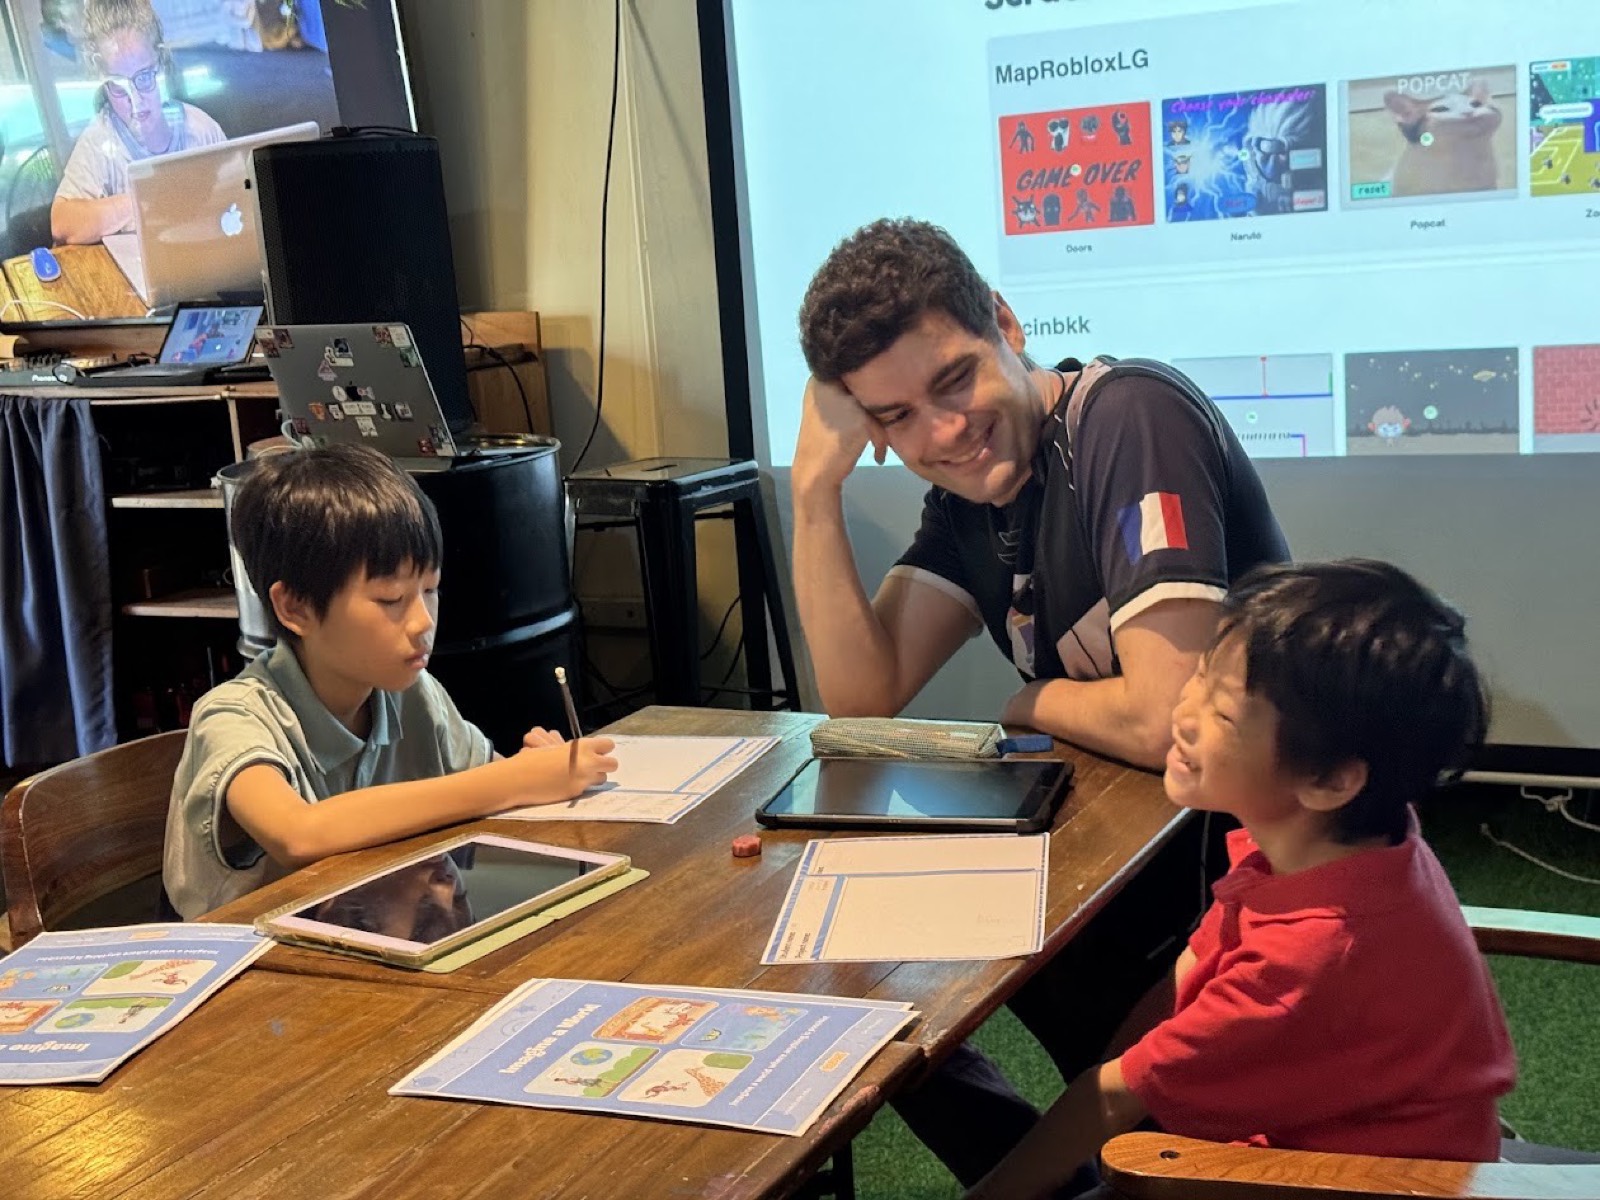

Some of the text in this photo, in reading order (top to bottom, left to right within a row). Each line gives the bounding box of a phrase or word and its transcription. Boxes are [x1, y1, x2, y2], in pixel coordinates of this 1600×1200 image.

[995, 48, 1149, 86] MapRobloxLG
[1397, 71, 1472, 95] POPCAT
[1016, 158, 1143, 192] GAME OVER
[1358, 183, 1388, 195] reset
[1410, 218, 1447, 230] Popcat
[1230, 231, 1263, 242] Naruto
[1066, 244, 1093, 254] Doors
[1022, 315, 1091, 336] cinbkk
[9, 1040, 91, 1053] Imagine
[498, 1003, 603, 1074] Imagine a World
